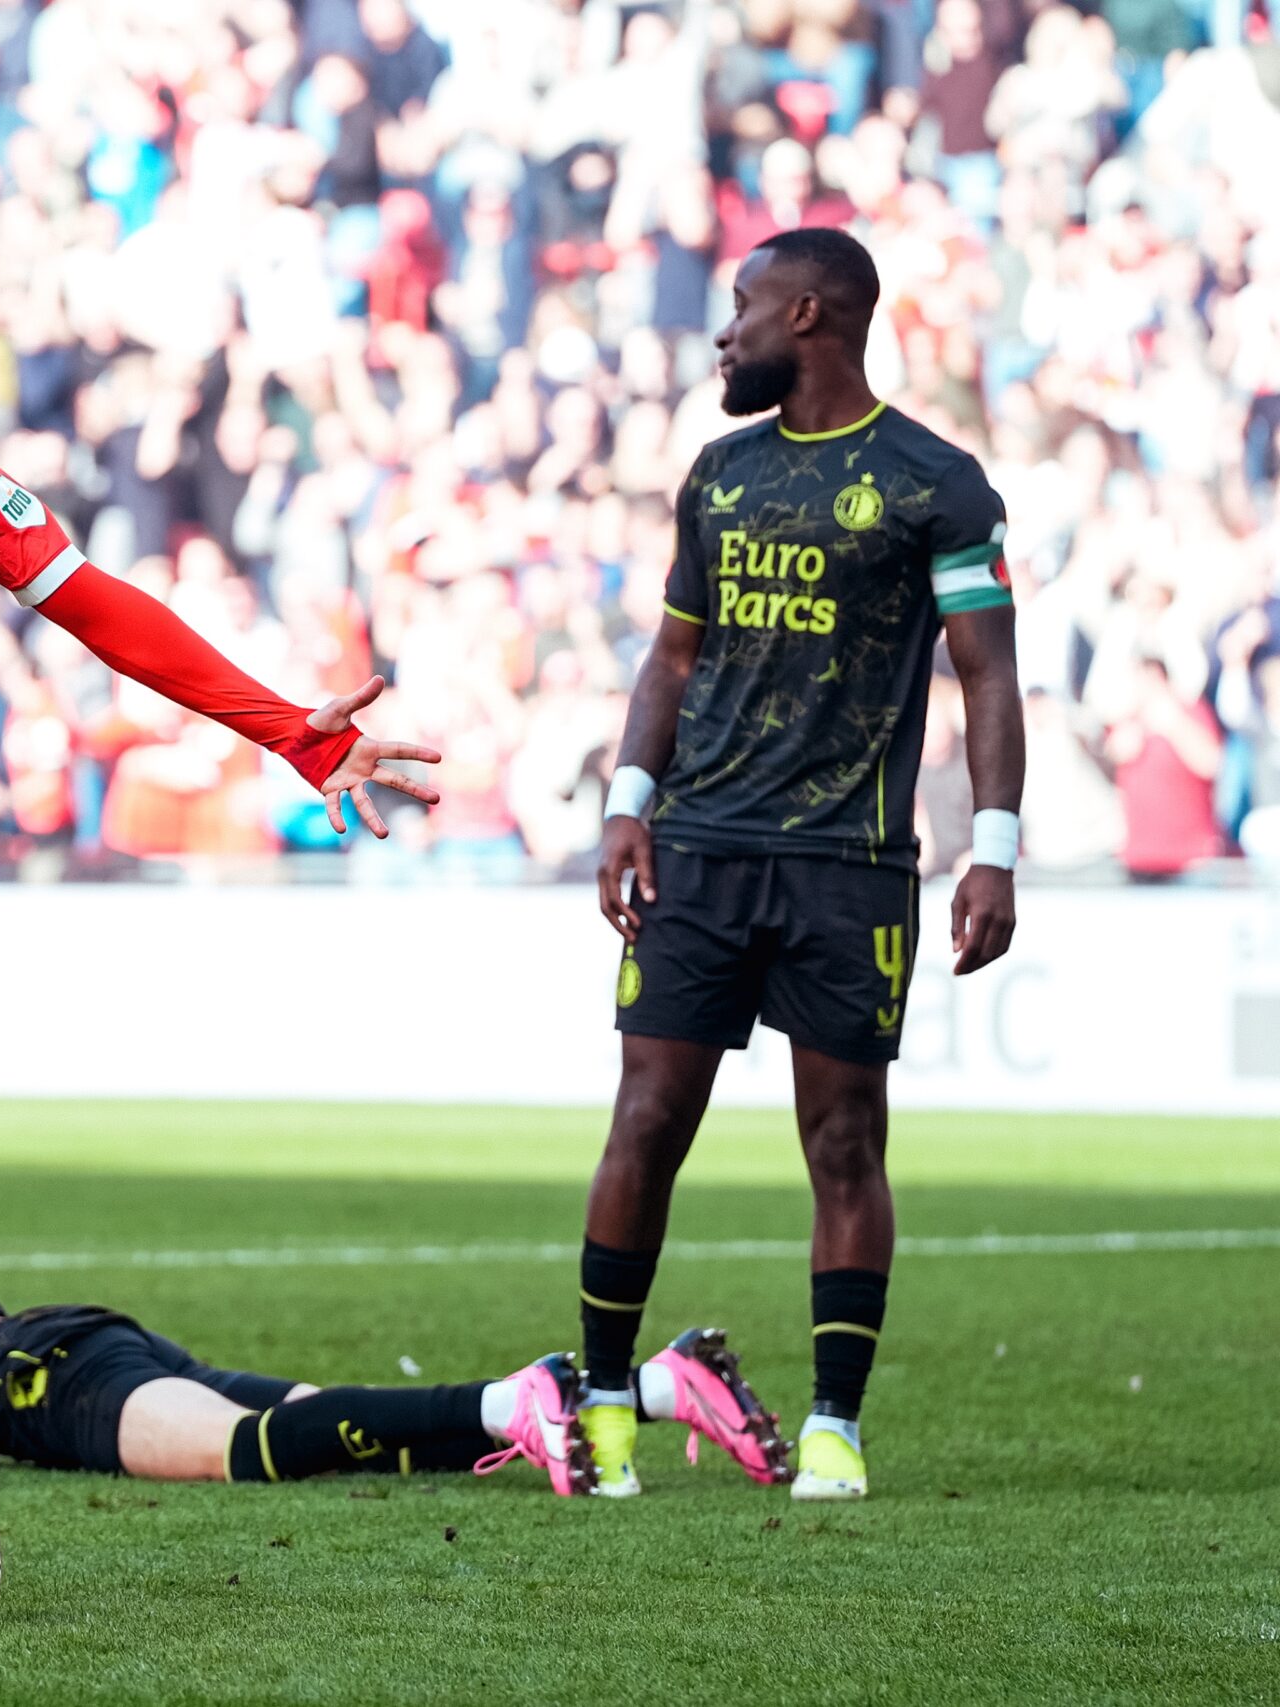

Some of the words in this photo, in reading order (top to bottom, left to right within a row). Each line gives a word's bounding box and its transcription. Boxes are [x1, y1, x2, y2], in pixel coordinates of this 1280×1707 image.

[2, 489, 32, 521] TOTO
[718, 530, 826, 583] Euro
[717, 580, 838, 635] Parcs
[873, 924, 903, 999] 4
